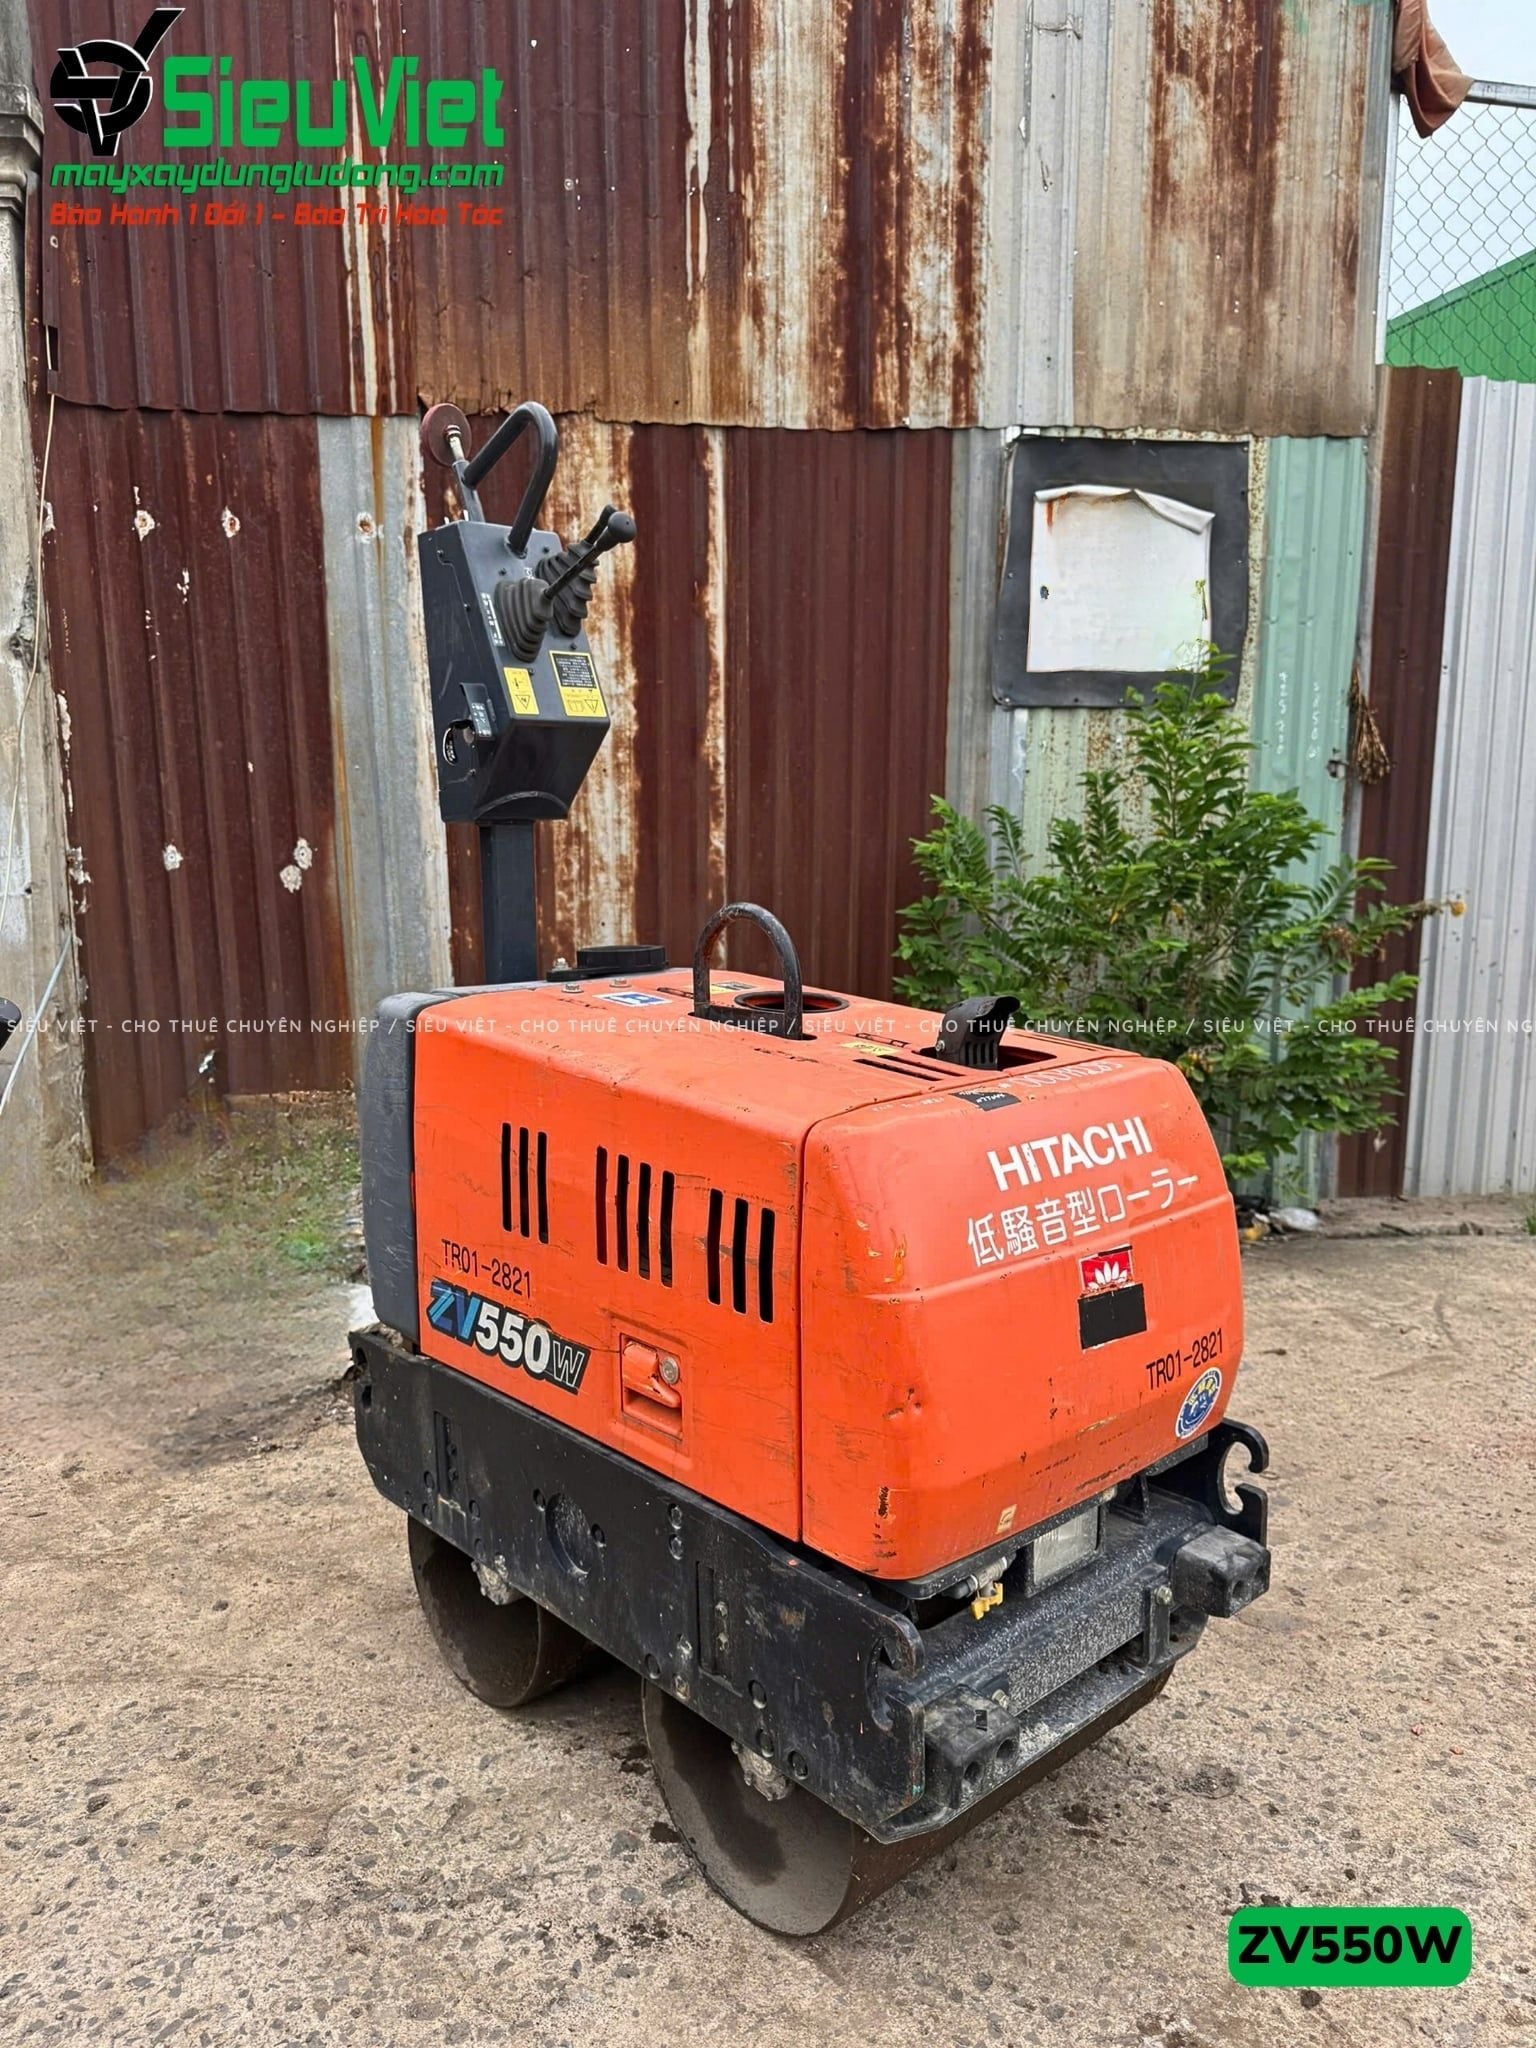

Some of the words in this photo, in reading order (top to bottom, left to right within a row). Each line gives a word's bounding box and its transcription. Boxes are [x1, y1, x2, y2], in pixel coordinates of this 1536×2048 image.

[987, 1116, 1154, 1192] HITACHI
[967, 1168, 1199, 1268] 低騒音型ローラー
[441, 1238, 531, 1299] TR01-2821
[426, 1280, 588, 1391] ZV550W
[1146, 1328, 1224, 1390] TR01-2821
